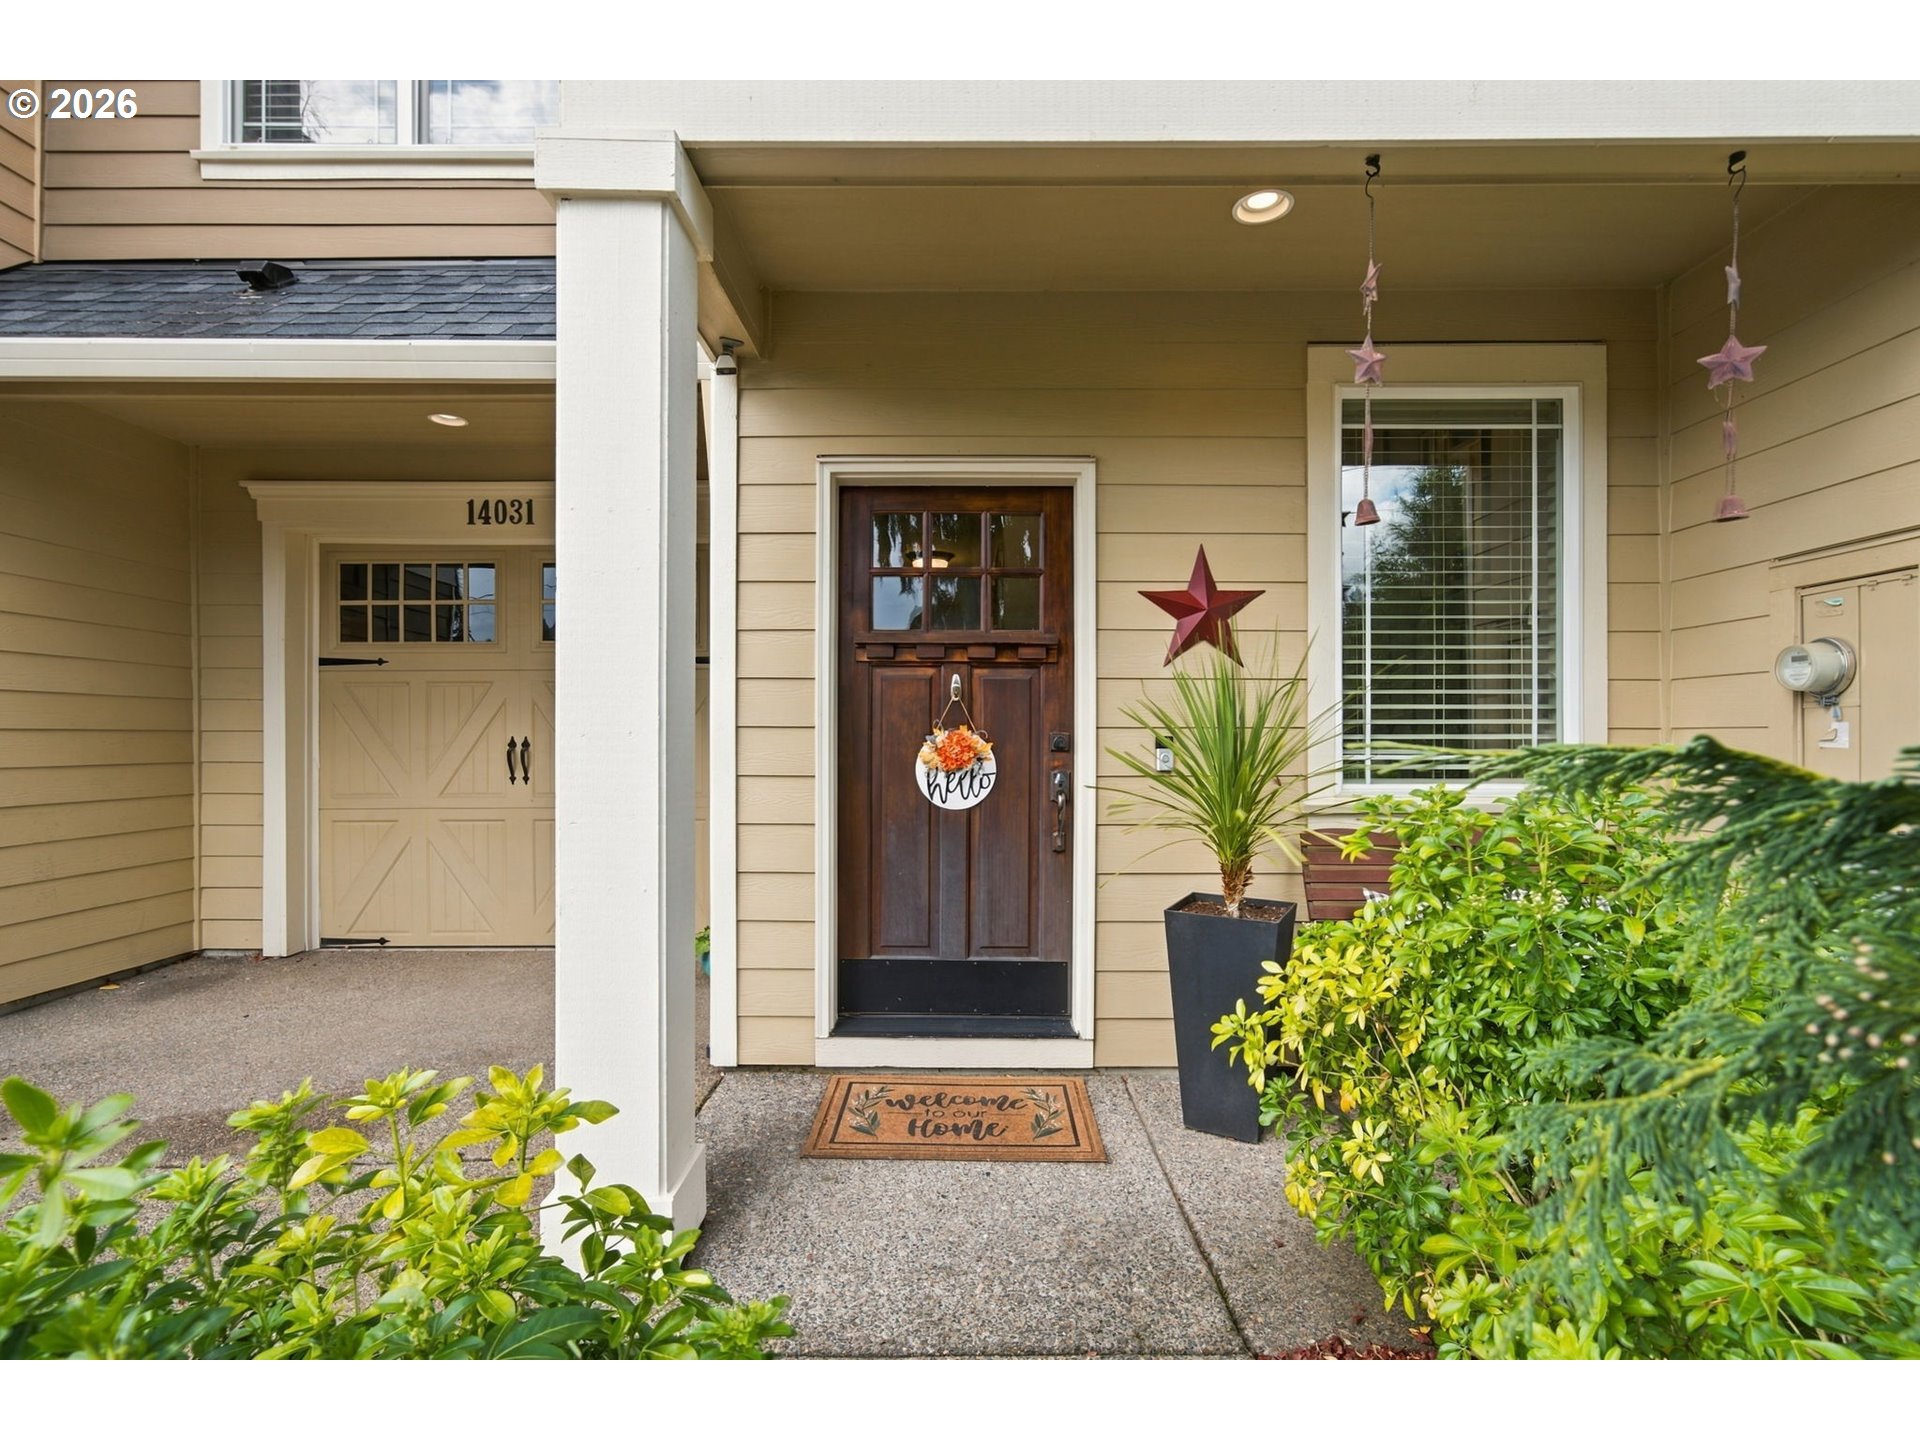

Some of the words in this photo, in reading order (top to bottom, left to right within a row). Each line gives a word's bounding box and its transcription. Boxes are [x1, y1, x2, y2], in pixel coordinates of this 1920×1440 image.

[466, 498, 535, 525] 14031
[926, 764, 996, 804] hello
[885, 1092, 1028, 1111] welcome
[924, 1108, 945, 1118] to
[952, 1110, 988, 1118] our
[907, 1118, 1009, 1141] Home
